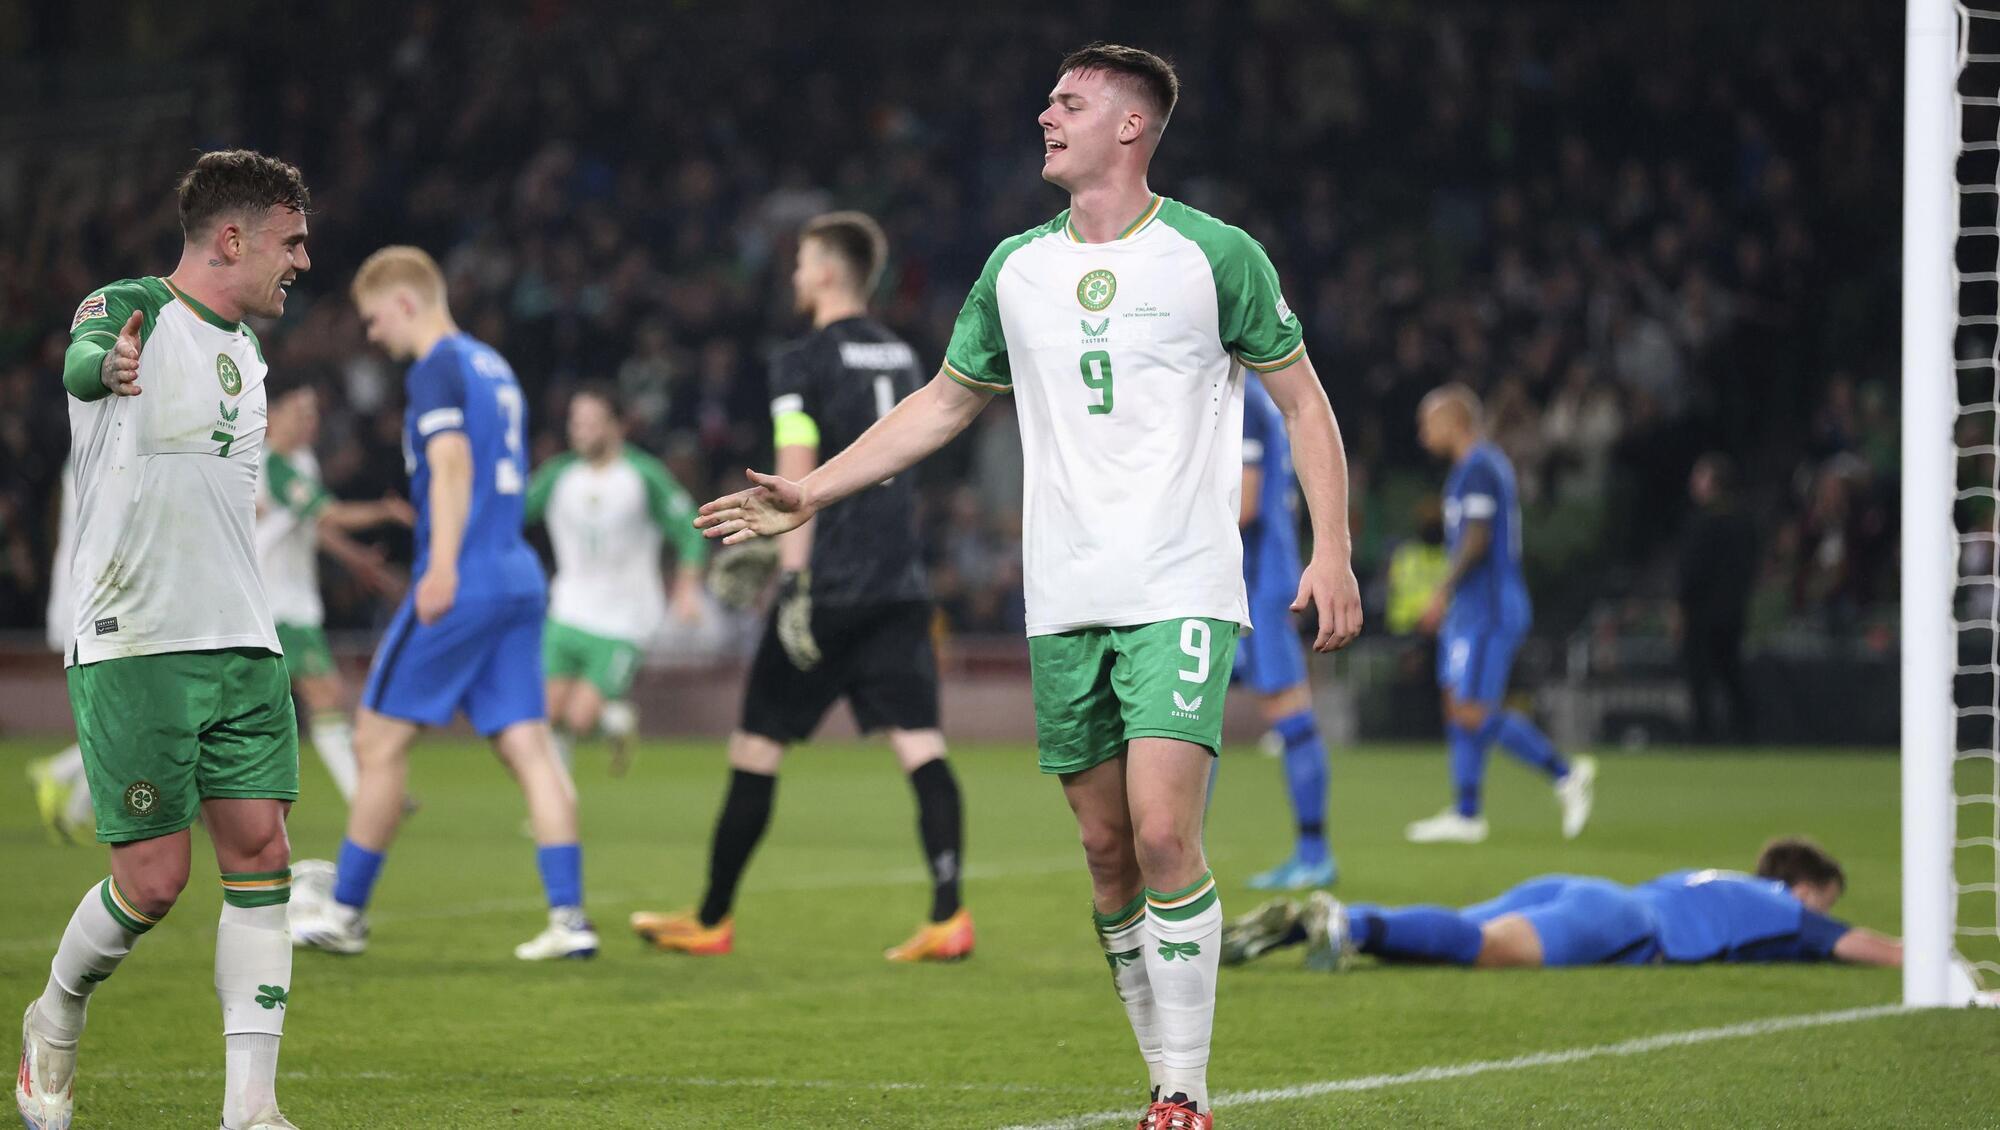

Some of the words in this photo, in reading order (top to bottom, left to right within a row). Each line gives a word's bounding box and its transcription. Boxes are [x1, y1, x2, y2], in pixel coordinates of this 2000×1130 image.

[1080, 350, 1113, 415] 9
[211, 430, 234, 457] 7
[1178, 619, 1211, 683] 9
